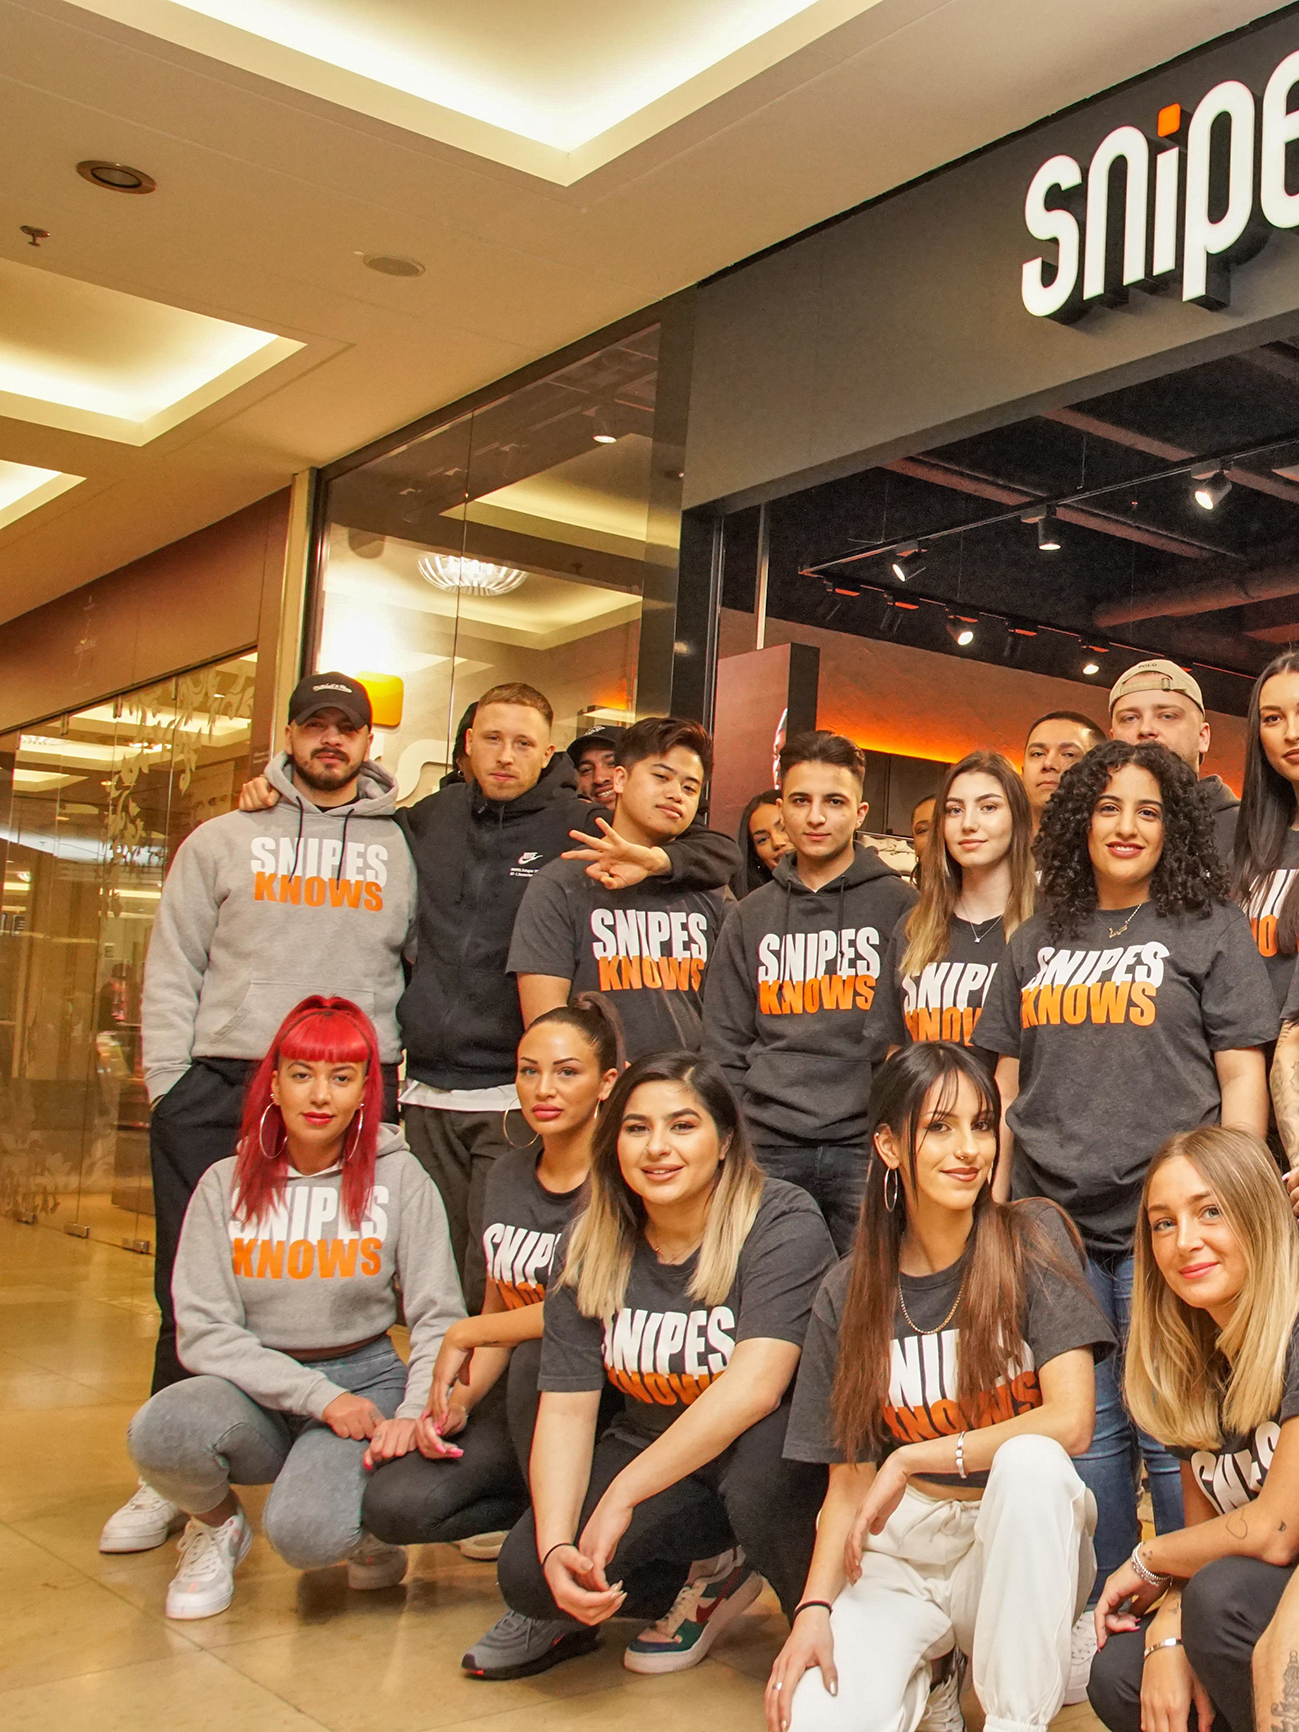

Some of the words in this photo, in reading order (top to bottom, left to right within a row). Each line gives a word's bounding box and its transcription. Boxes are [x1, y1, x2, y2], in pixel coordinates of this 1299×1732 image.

[250, 837, 388, 889] SNIPES
[254, 871, 384, 912] KNOWS
[590, 908, 708, 963] SNIPES
[758, 926, 880, 986] SNIPES
[598, 955, 705, 992] KNOWS
[1022, 941, 1170, 993] SNIPES
[759, 974, 877, 1015] KNOWS
[1020, 981, 1157, 1029] KNOWS
[233, 1237, 383, 1280] KNOWS
